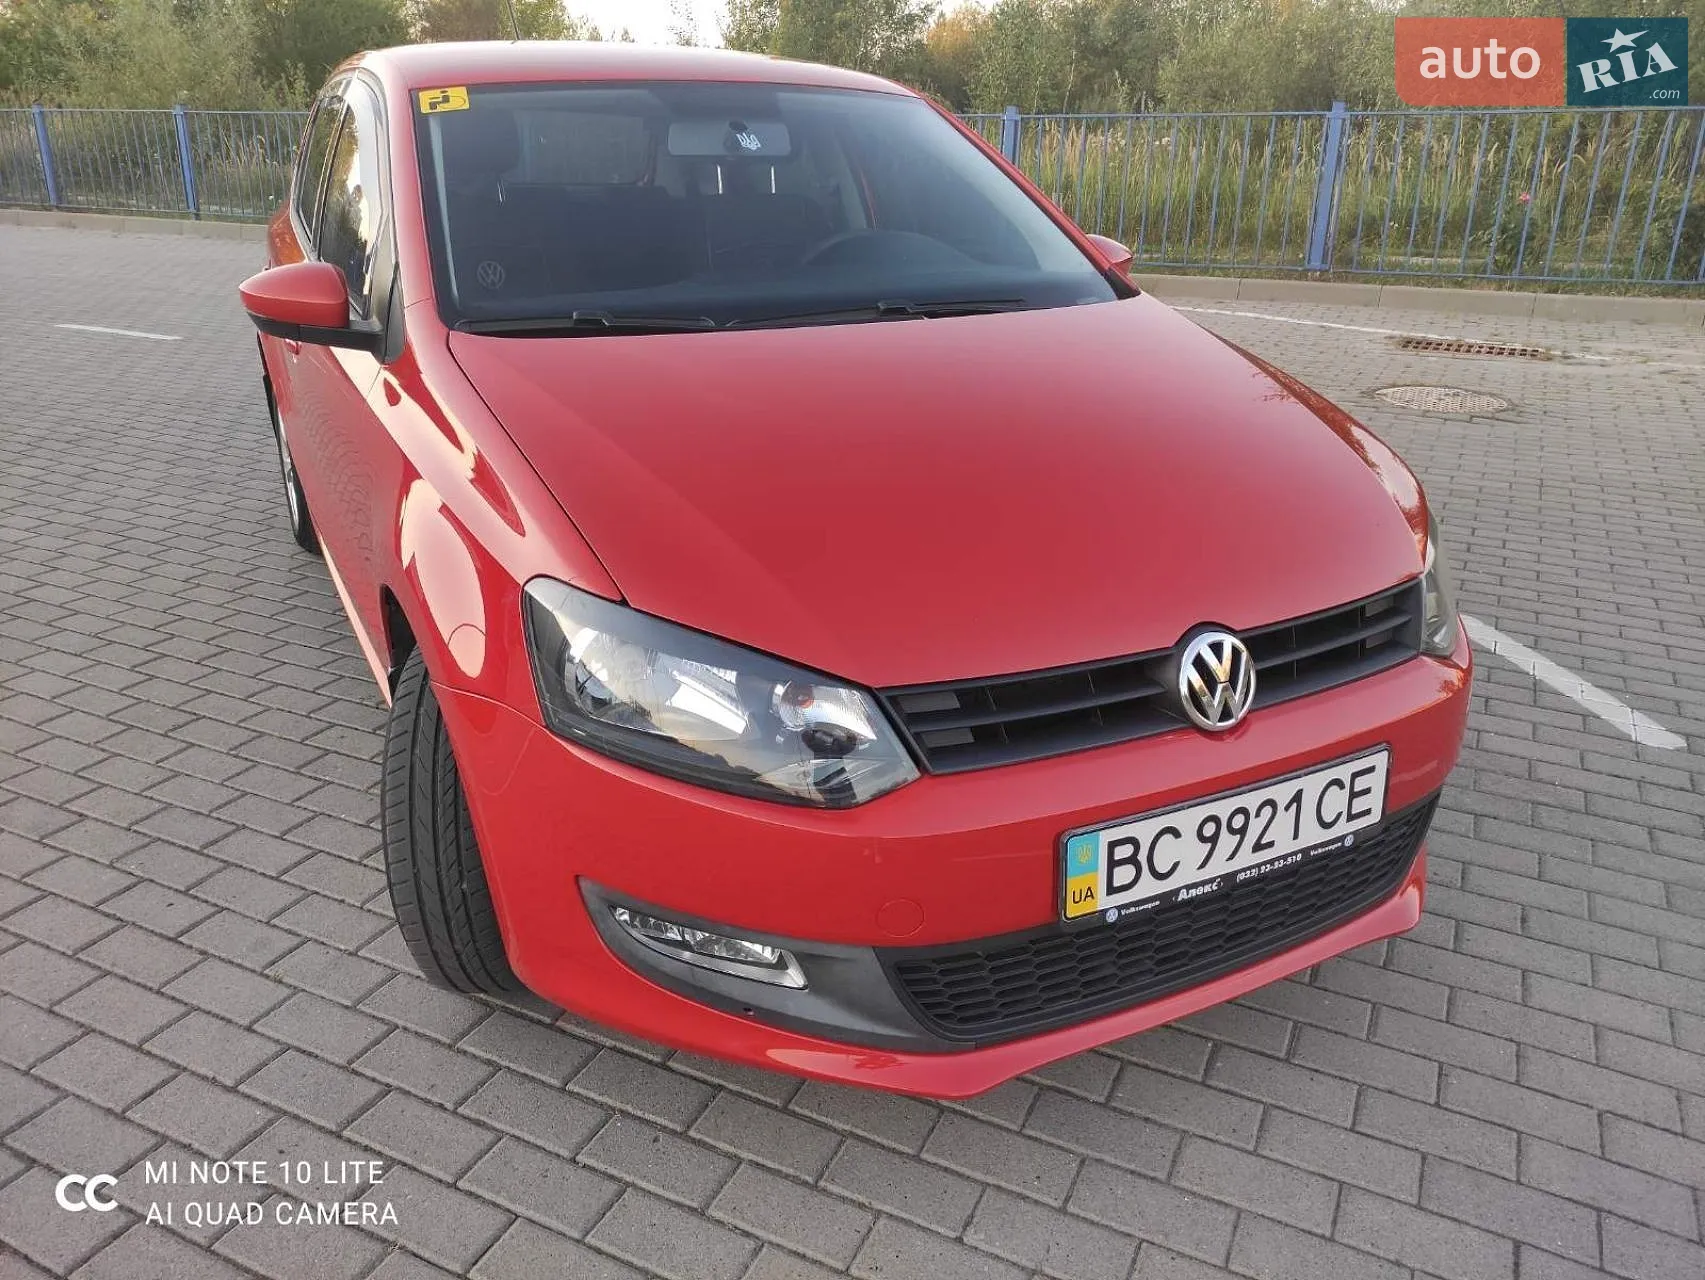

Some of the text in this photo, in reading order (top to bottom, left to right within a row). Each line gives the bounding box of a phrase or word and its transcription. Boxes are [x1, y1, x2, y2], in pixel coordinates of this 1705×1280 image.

[1105, 764, 1377, 896] BC 9921 CE
[1071, 886, 1095, 905] UA
